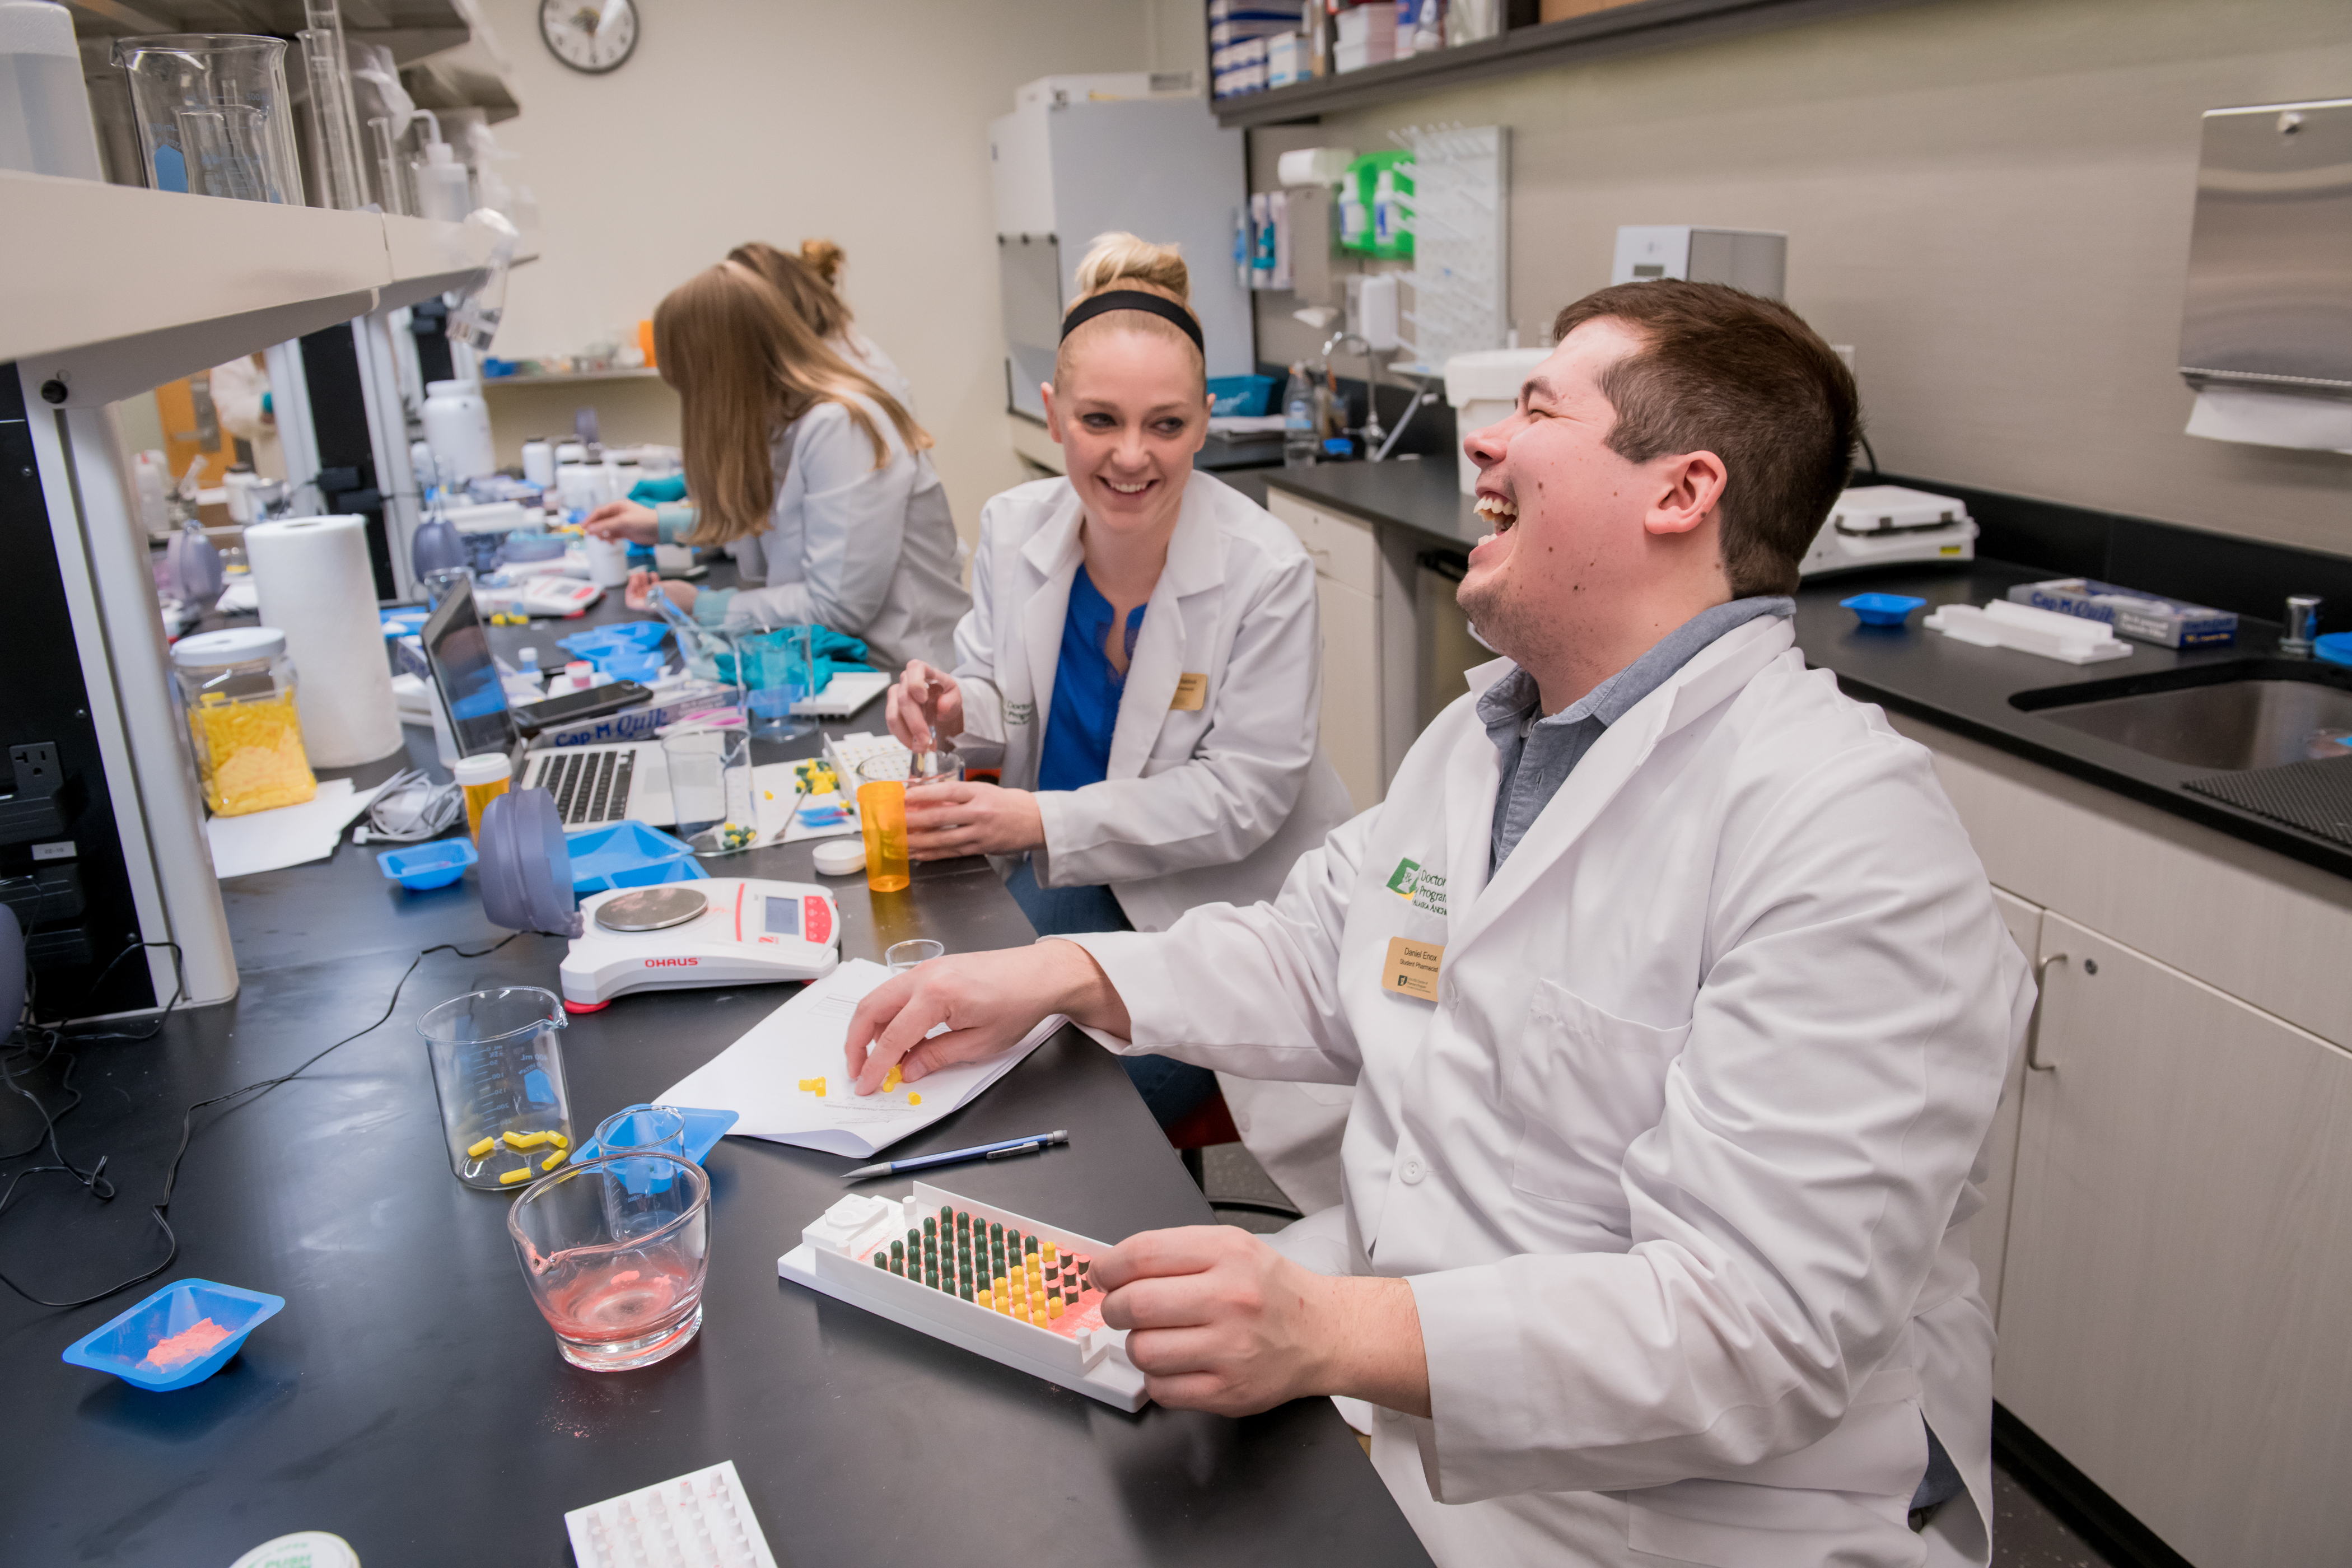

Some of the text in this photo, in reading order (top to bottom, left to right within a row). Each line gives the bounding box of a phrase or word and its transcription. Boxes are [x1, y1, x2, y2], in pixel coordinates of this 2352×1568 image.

[1421, 870, 1446, 888] Doctor
[1404, 948, 1438, 962] Daniel Enox
[1399, 958, 1439, 973] Student Pharmacist
